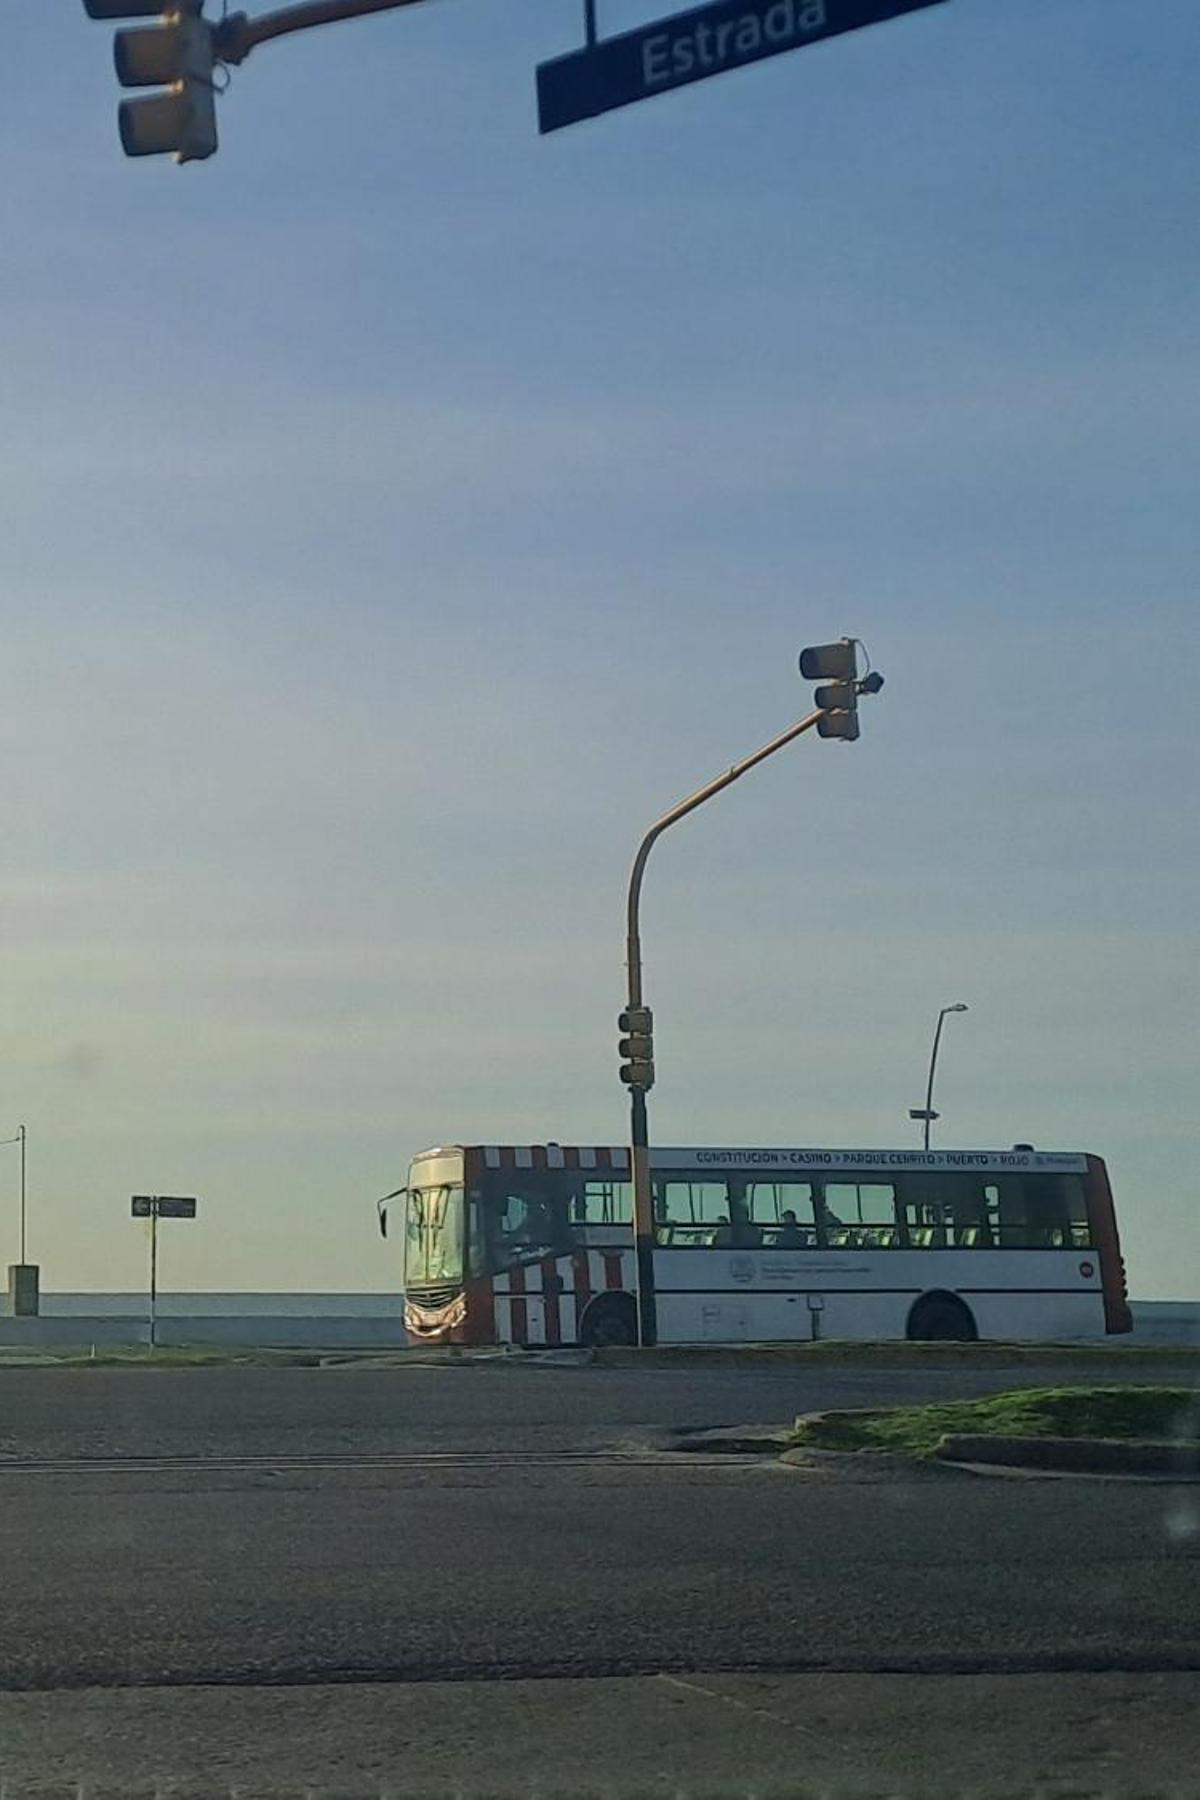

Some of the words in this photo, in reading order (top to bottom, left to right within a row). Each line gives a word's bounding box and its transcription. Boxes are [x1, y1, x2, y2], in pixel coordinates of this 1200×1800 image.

[643, 0, 826, 83] Estrada
[790, 1152, 831, 1164] CASINO
[843, 1153, 888, 1165] PARQUE
[946, 1154, 988, 1166] PUERTO
